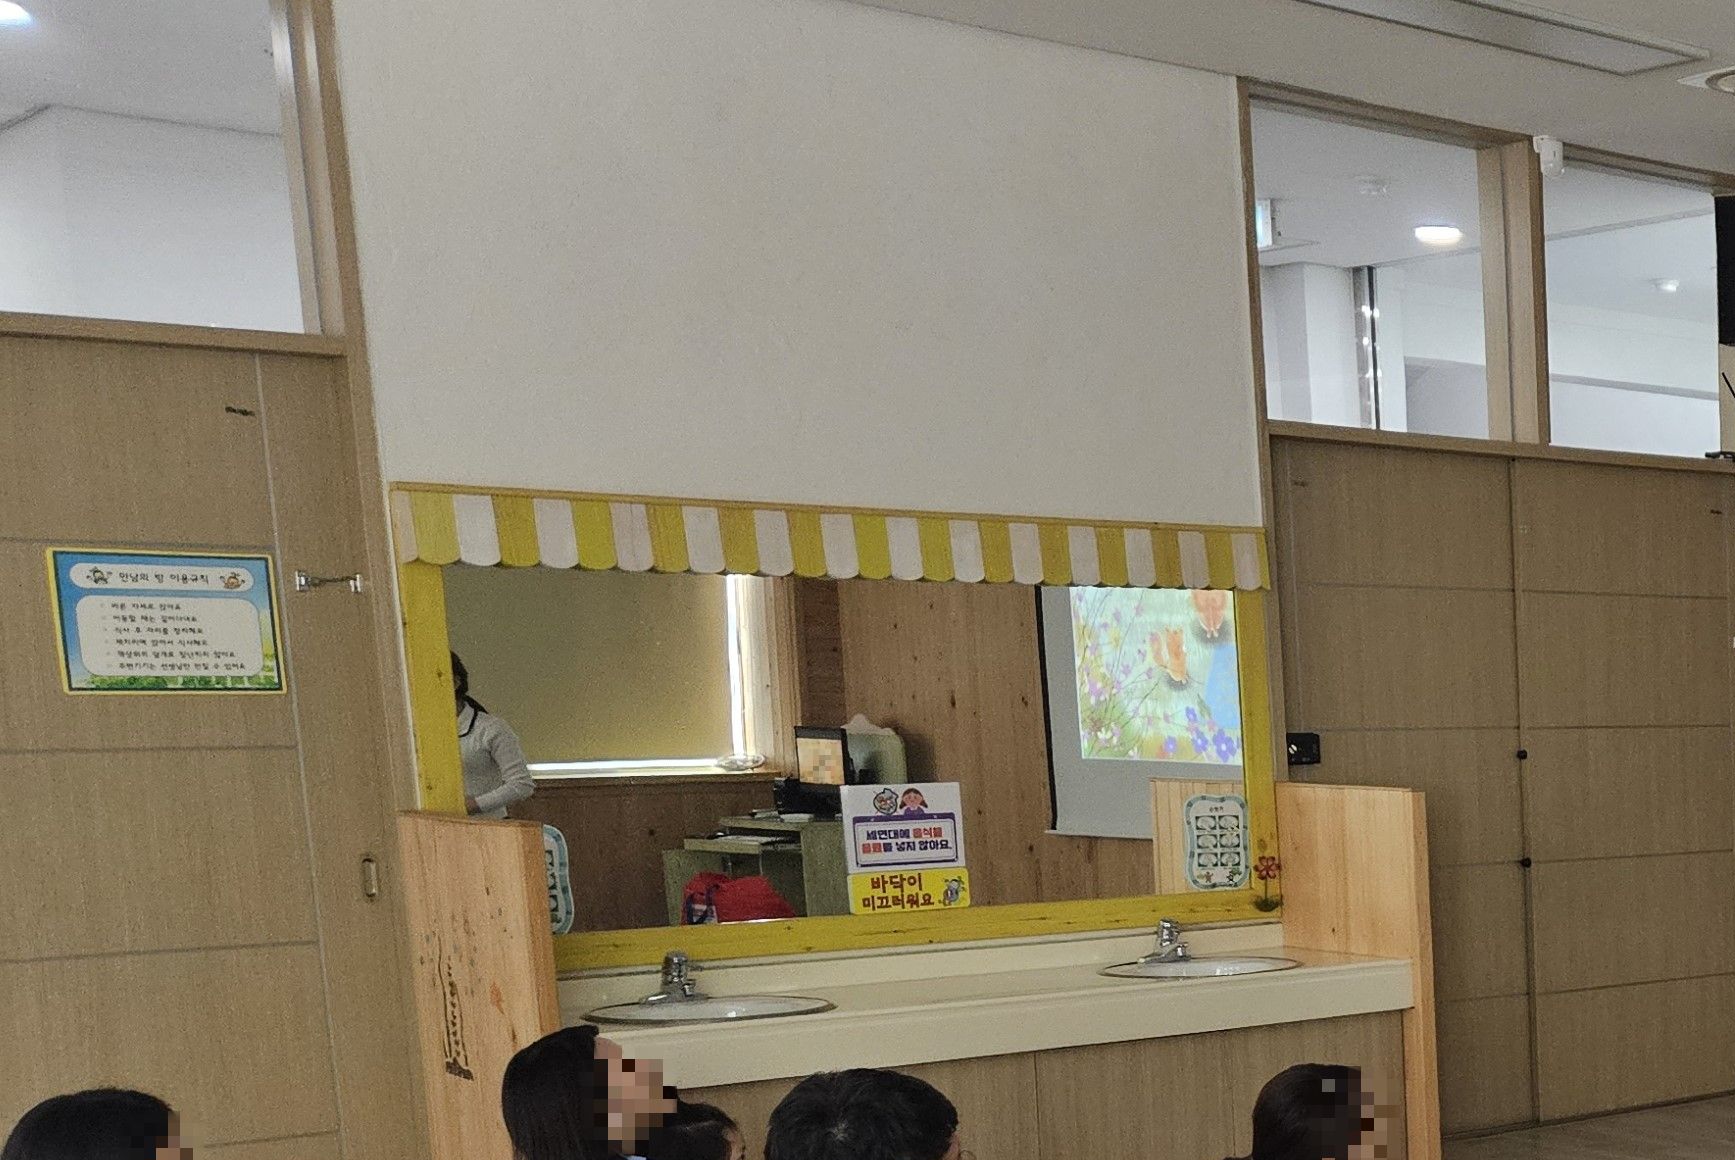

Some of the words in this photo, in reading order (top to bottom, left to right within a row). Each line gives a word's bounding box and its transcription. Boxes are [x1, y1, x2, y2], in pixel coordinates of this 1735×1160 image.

[896, 840, 916, 852] 넣지
[918, 839, 952, 851] 않아요.
[870, 872, 923, 893] 바닥이
[862, 892, 935, 911] 미끄러워요
